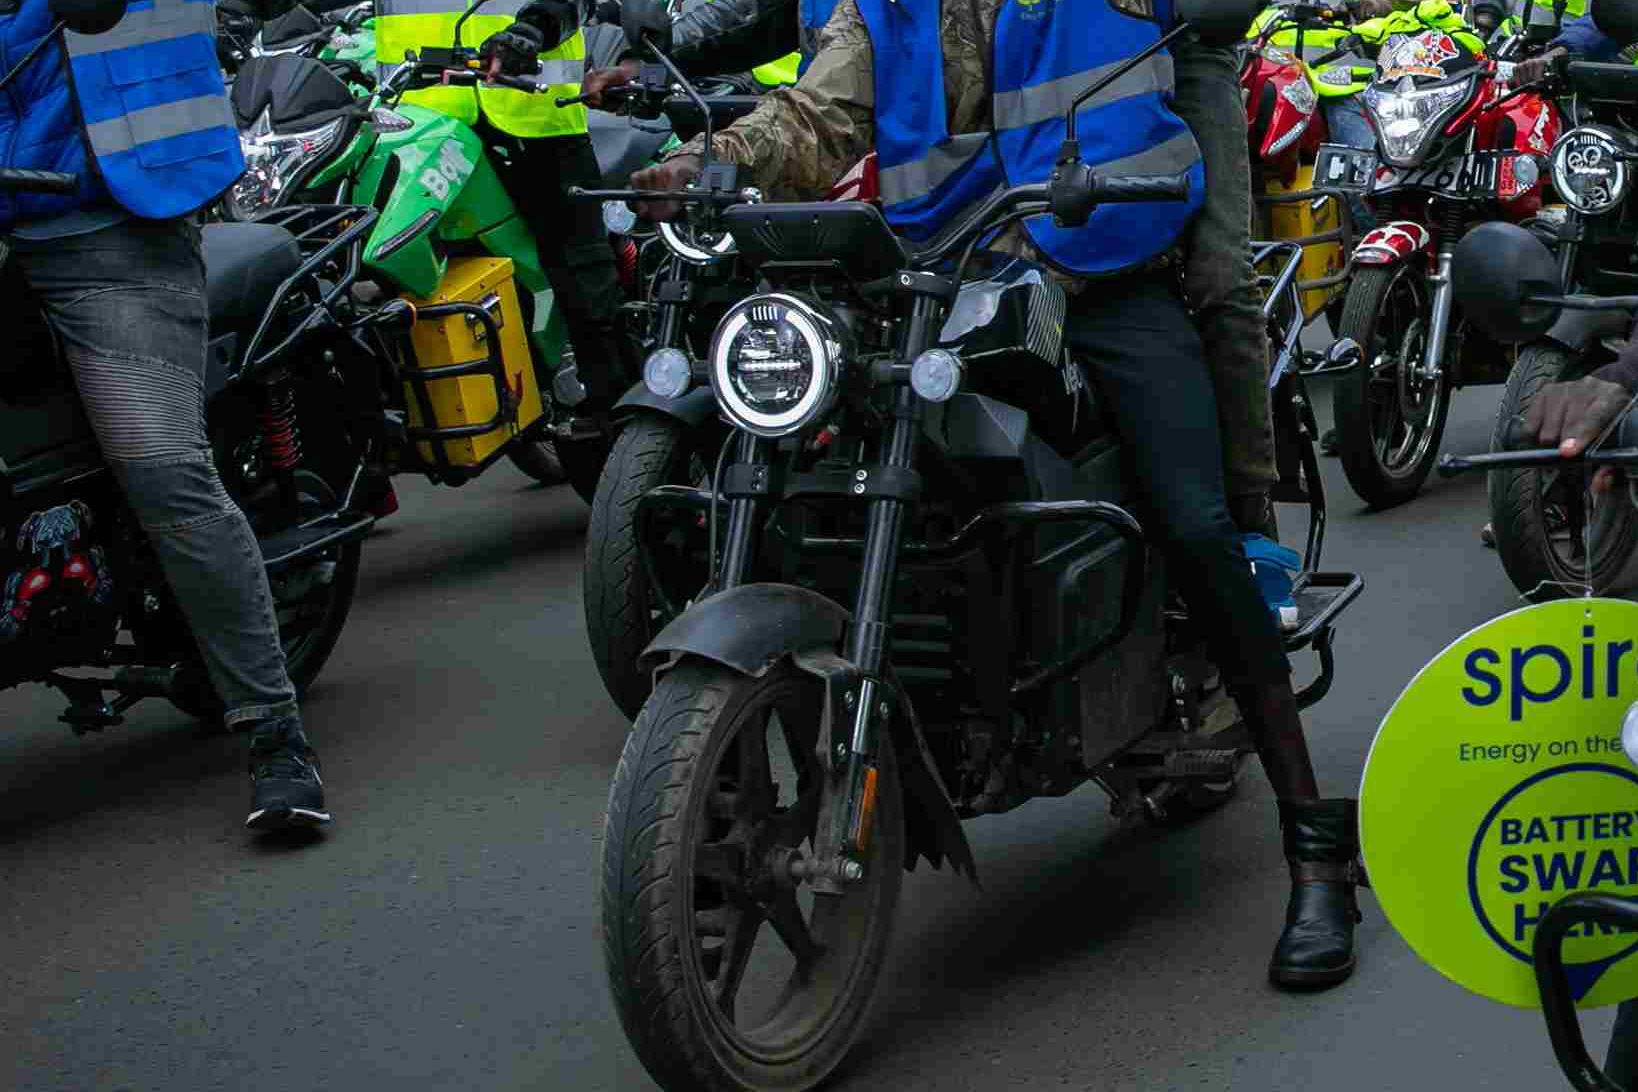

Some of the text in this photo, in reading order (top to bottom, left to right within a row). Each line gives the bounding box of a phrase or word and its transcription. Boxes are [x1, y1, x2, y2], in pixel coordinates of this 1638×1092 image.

[1459, 735, 1622, 764] Energy on the
